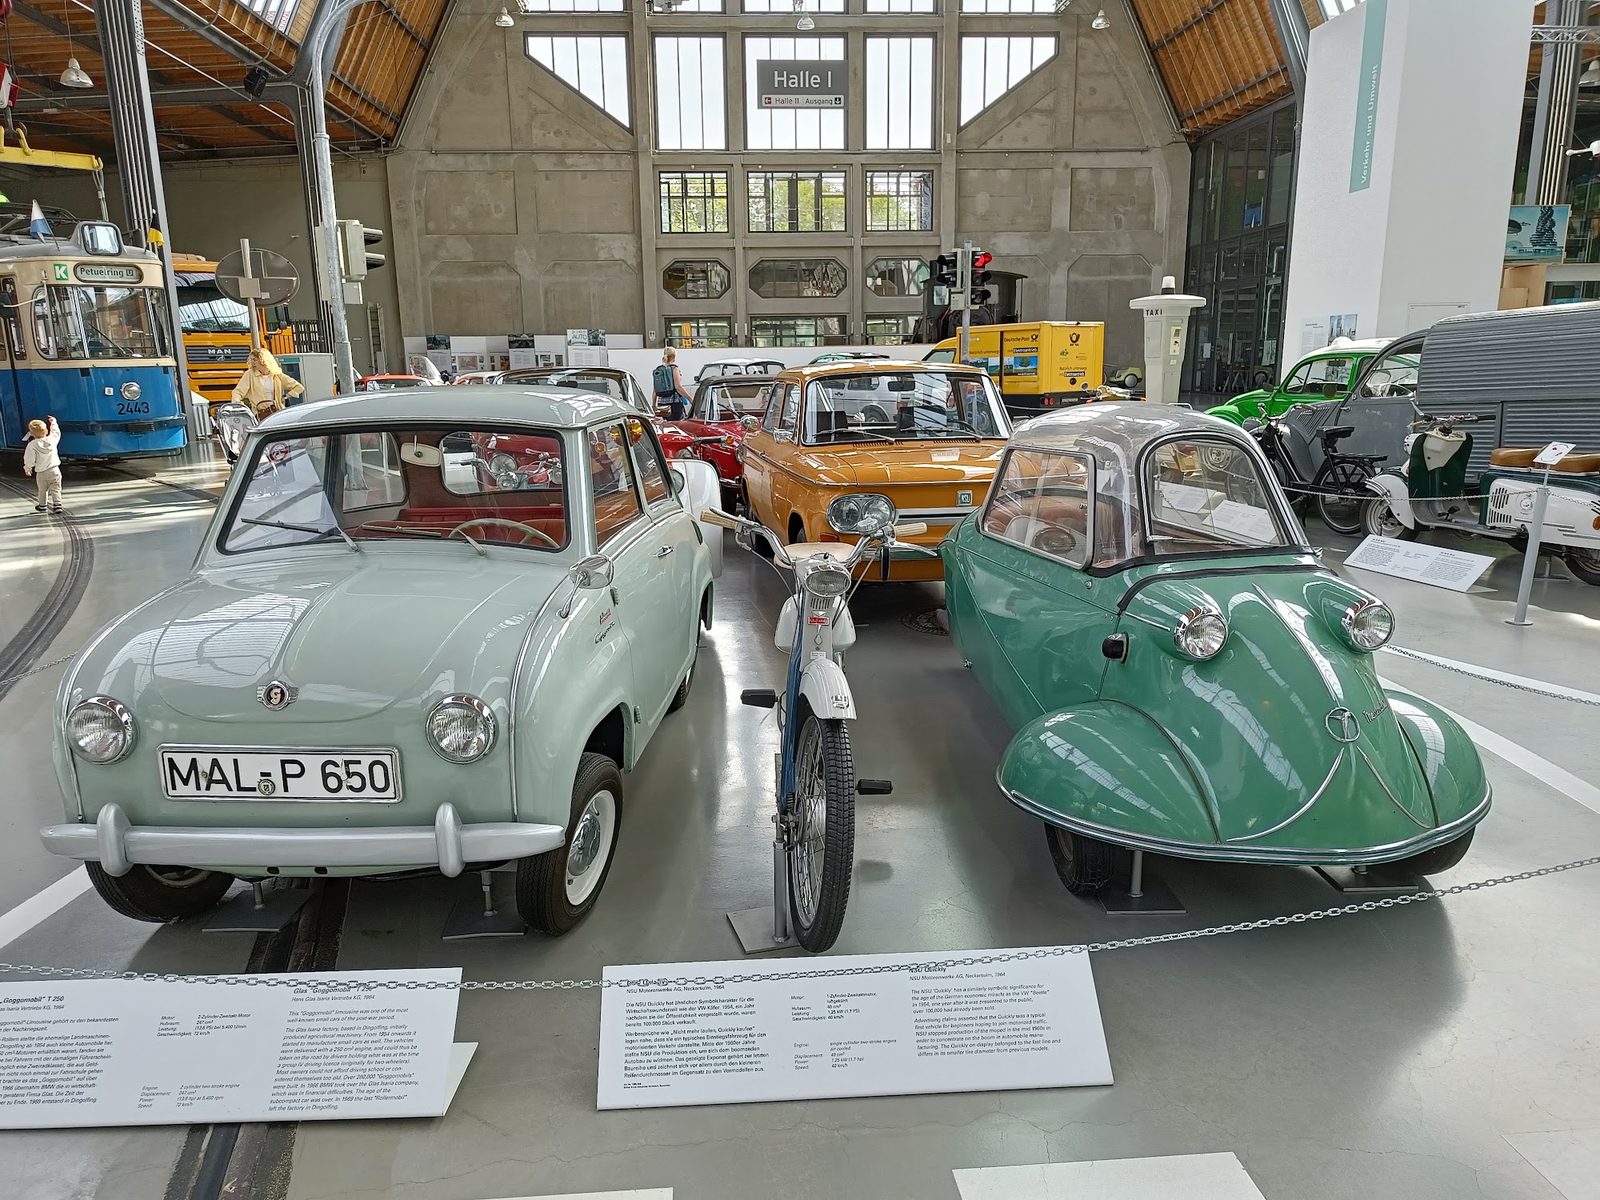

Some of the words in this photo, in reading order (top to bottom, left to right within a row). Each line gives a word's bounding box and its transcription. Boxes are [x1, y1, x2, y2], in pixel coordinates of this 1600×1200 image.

[774, 70, 821, 88] Halle
[827, 70, 832, 88] I
[805, 97, 833, 105] Ausgang
[1361, 141, 1370, 183] Verkehr
[1368, 64, 1378, 111] Umwelt
[55, 266, 68, 279] K
[80, 267, 124, 277] Petuelring
[118, 402, 150, 414] 2443
[321, 760, 390, 793] 650
[698, 997, 737, 1006] Symbolcharakter
